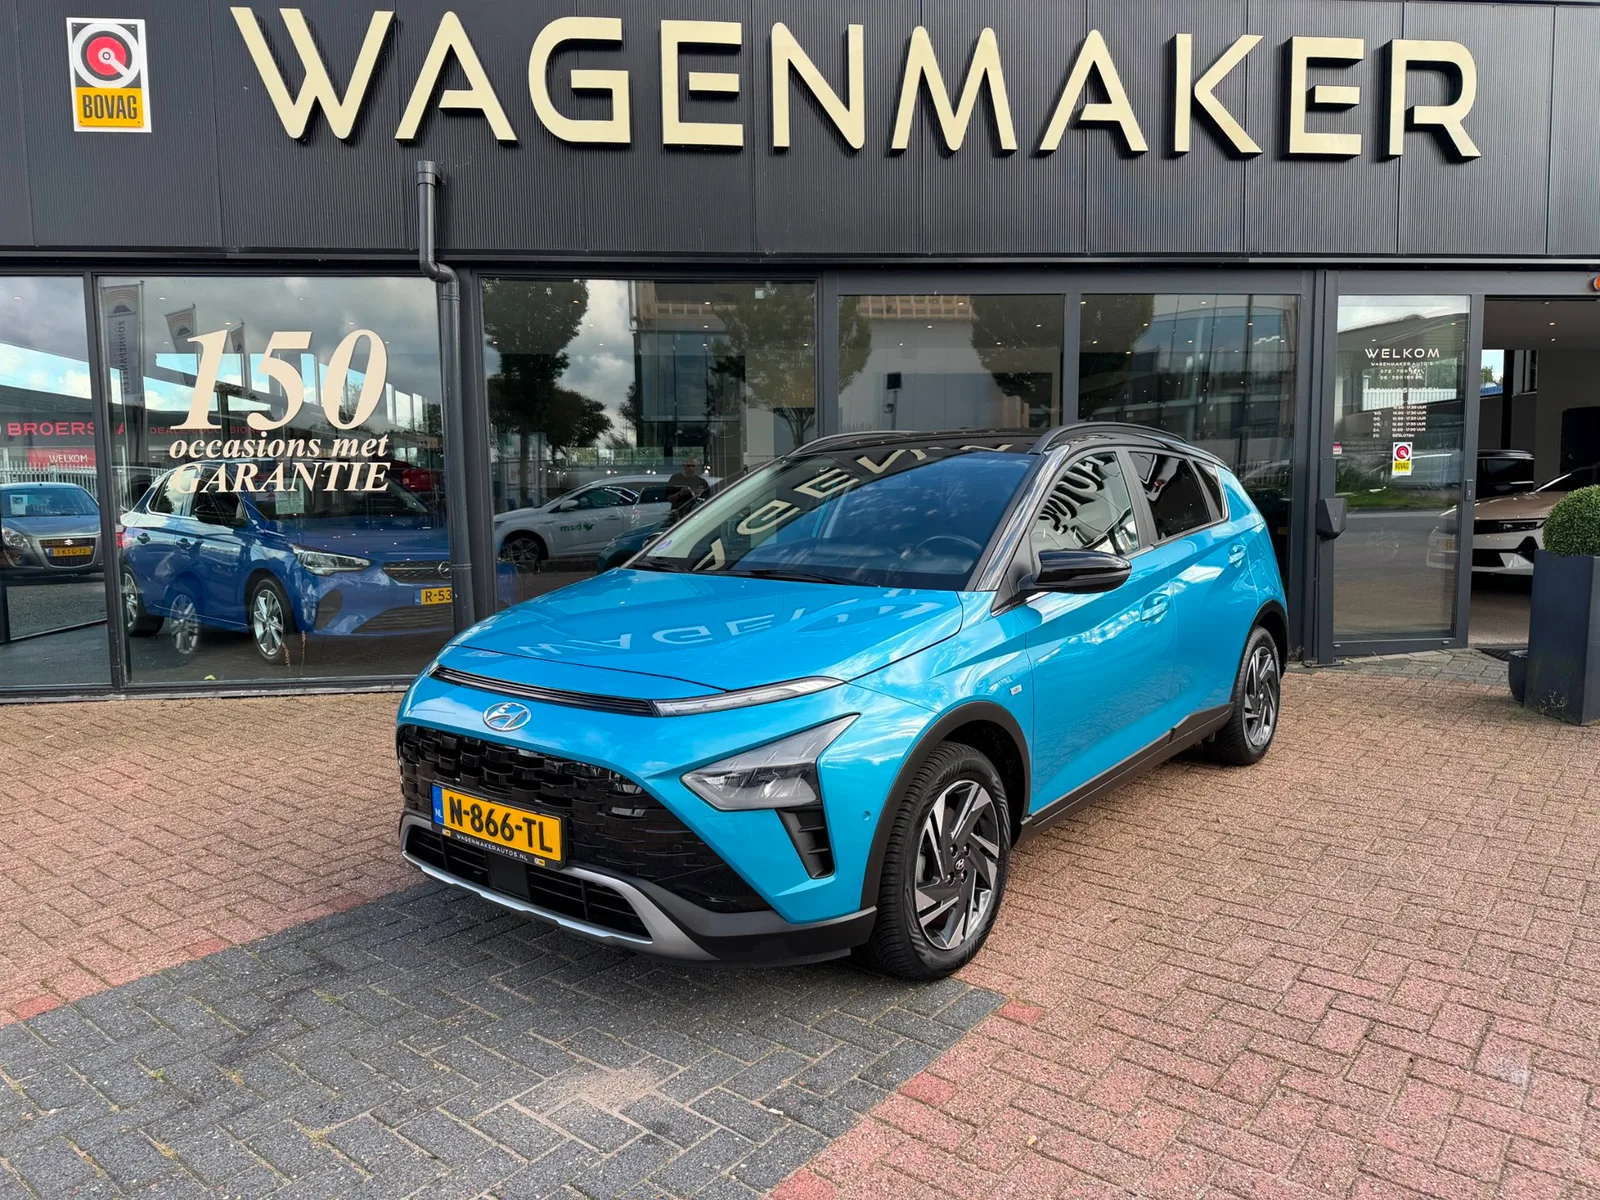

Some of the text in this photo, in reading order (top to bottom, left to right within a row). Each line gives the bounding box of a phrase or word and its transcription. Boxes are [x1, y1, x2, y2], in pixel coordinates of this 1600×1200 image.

[230, 7, 1481, 158] WAGENMAKER
[82, 94, 138, 119] BOVAG
[1364, 347, 1440, 359] WELKOM
[170, 328, 388, 430] 150
[48, 453, 88, 463] WELKOM
[169, 430, 390, 459] occasions met
[171, 462, 391, 494] GARANTIE
[434, 807, 443, 819] NL
[448, 796, 553, 853] N-866-TL
[456, 834, 528, 861] WAGENMAKERAUTOS.NL
